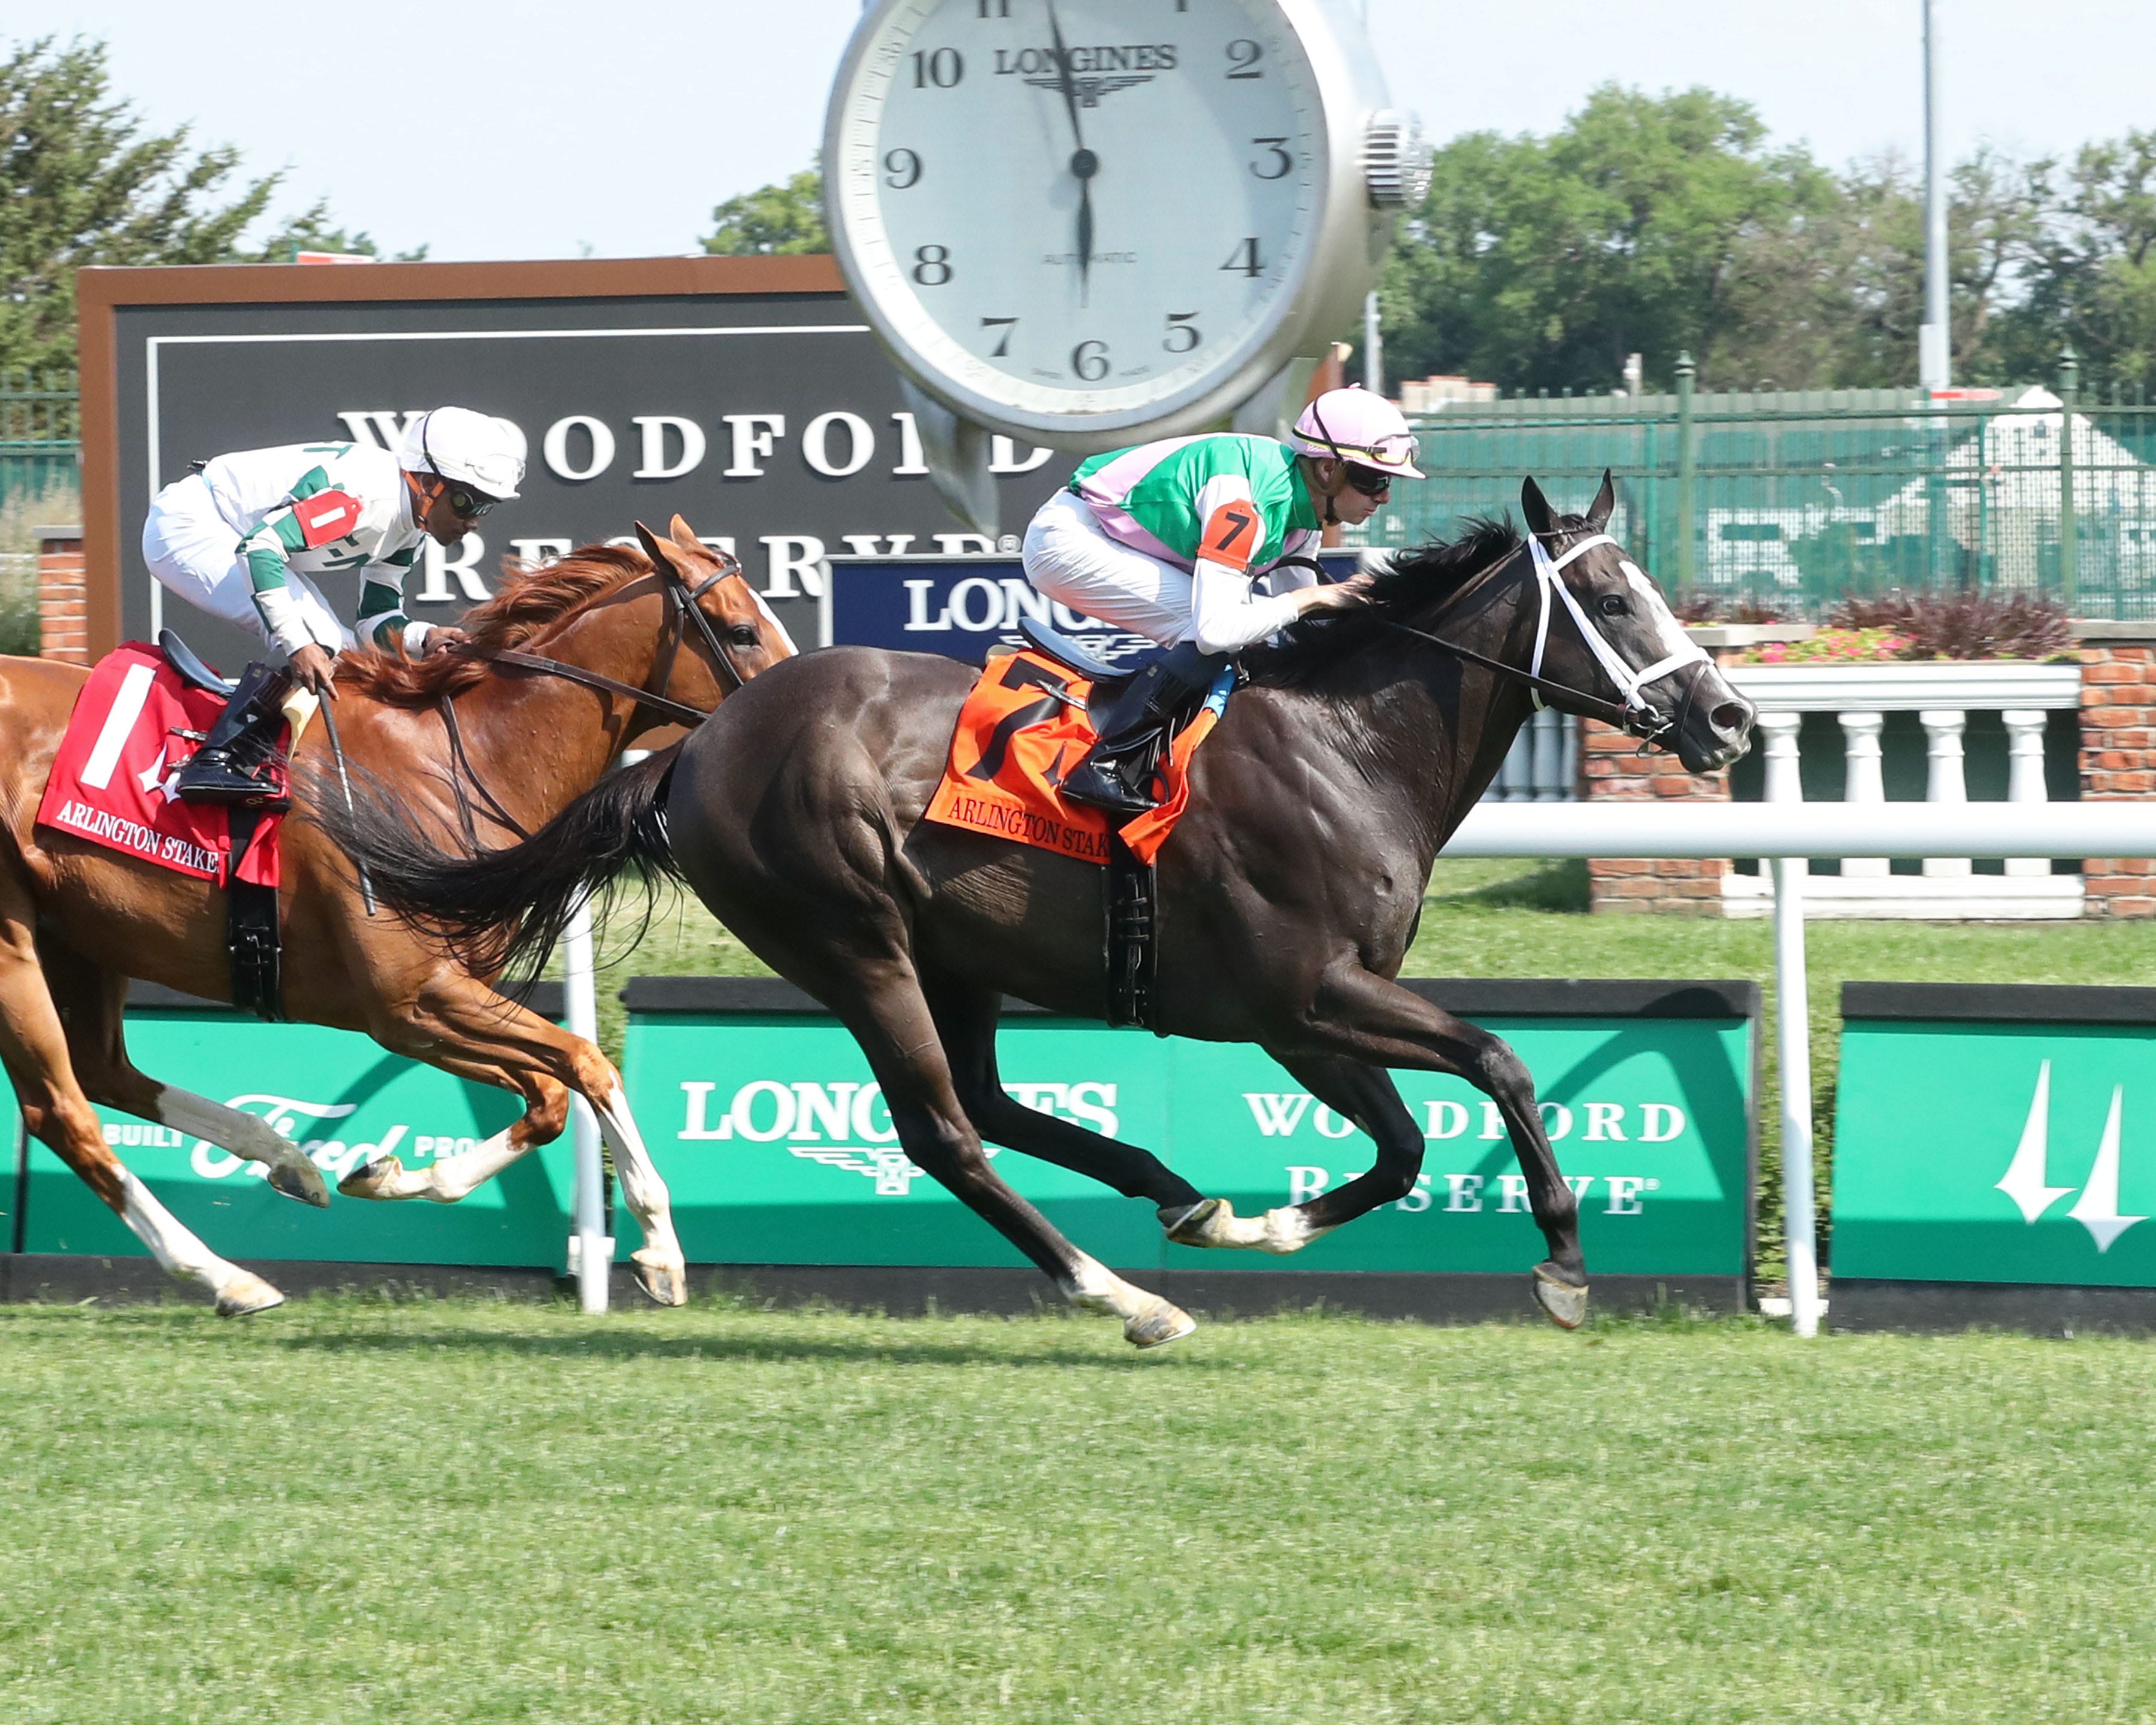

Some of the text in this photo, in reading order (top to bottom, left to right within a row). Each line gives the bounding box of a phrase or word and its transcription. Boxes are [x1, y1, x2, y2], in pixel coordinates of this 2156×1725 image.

[910, 47, 965, 89] 10
[1225, 39, 1264, 80] 2
[885, 147, 925, 190] 9
[1250, 137, 1294, 180] 3
[912, 244, 957, 286] 8
[1220, 237, 1267, 279] 4
[980, 317, 1019, 357] 7
[1162, 311, 1201, 353] 5
[1070, 340, 1110, 382] 6
[310, 506, 346, 529] 1
[1216, 512, 1250, 551] 7
[80, 663, 157, 789] 1
[965, 658, 1069, 781] 7
[57, 800, 220, 873] ARLINGTON STAKE
[947, 797, 1061, 844] ARLINGTON
[677, 1080, 1119, 1143] LONGES
[1242, 1092, 1686, 1142] WODFORD
[102, 1124, 183, 1148] BUILT
[414, 1136, 484, 1158] PRO
